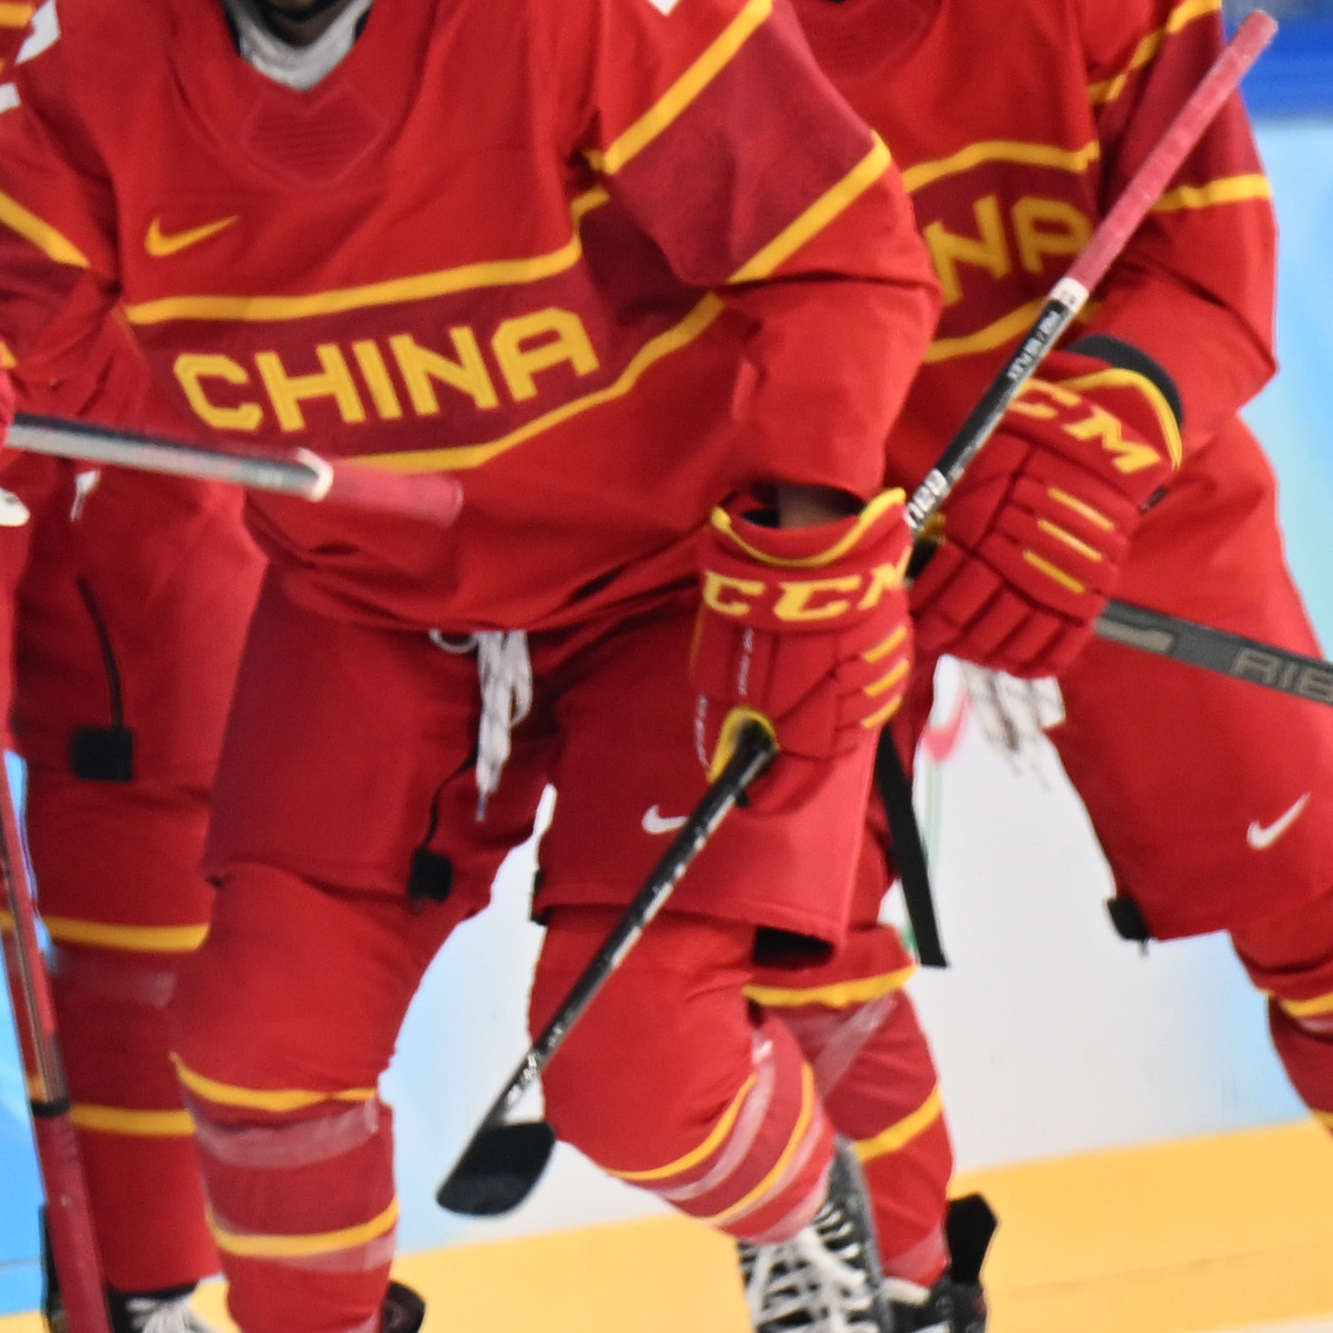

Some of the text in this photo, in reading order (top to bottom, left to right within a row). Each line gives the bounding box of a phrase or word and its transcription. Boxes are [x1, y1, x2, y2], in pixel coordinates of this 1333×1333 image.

[173, 306, 601, 434] CHINA
[1007, 376, 1162, 475] CM
[704, 548, 913, 621] CCM
